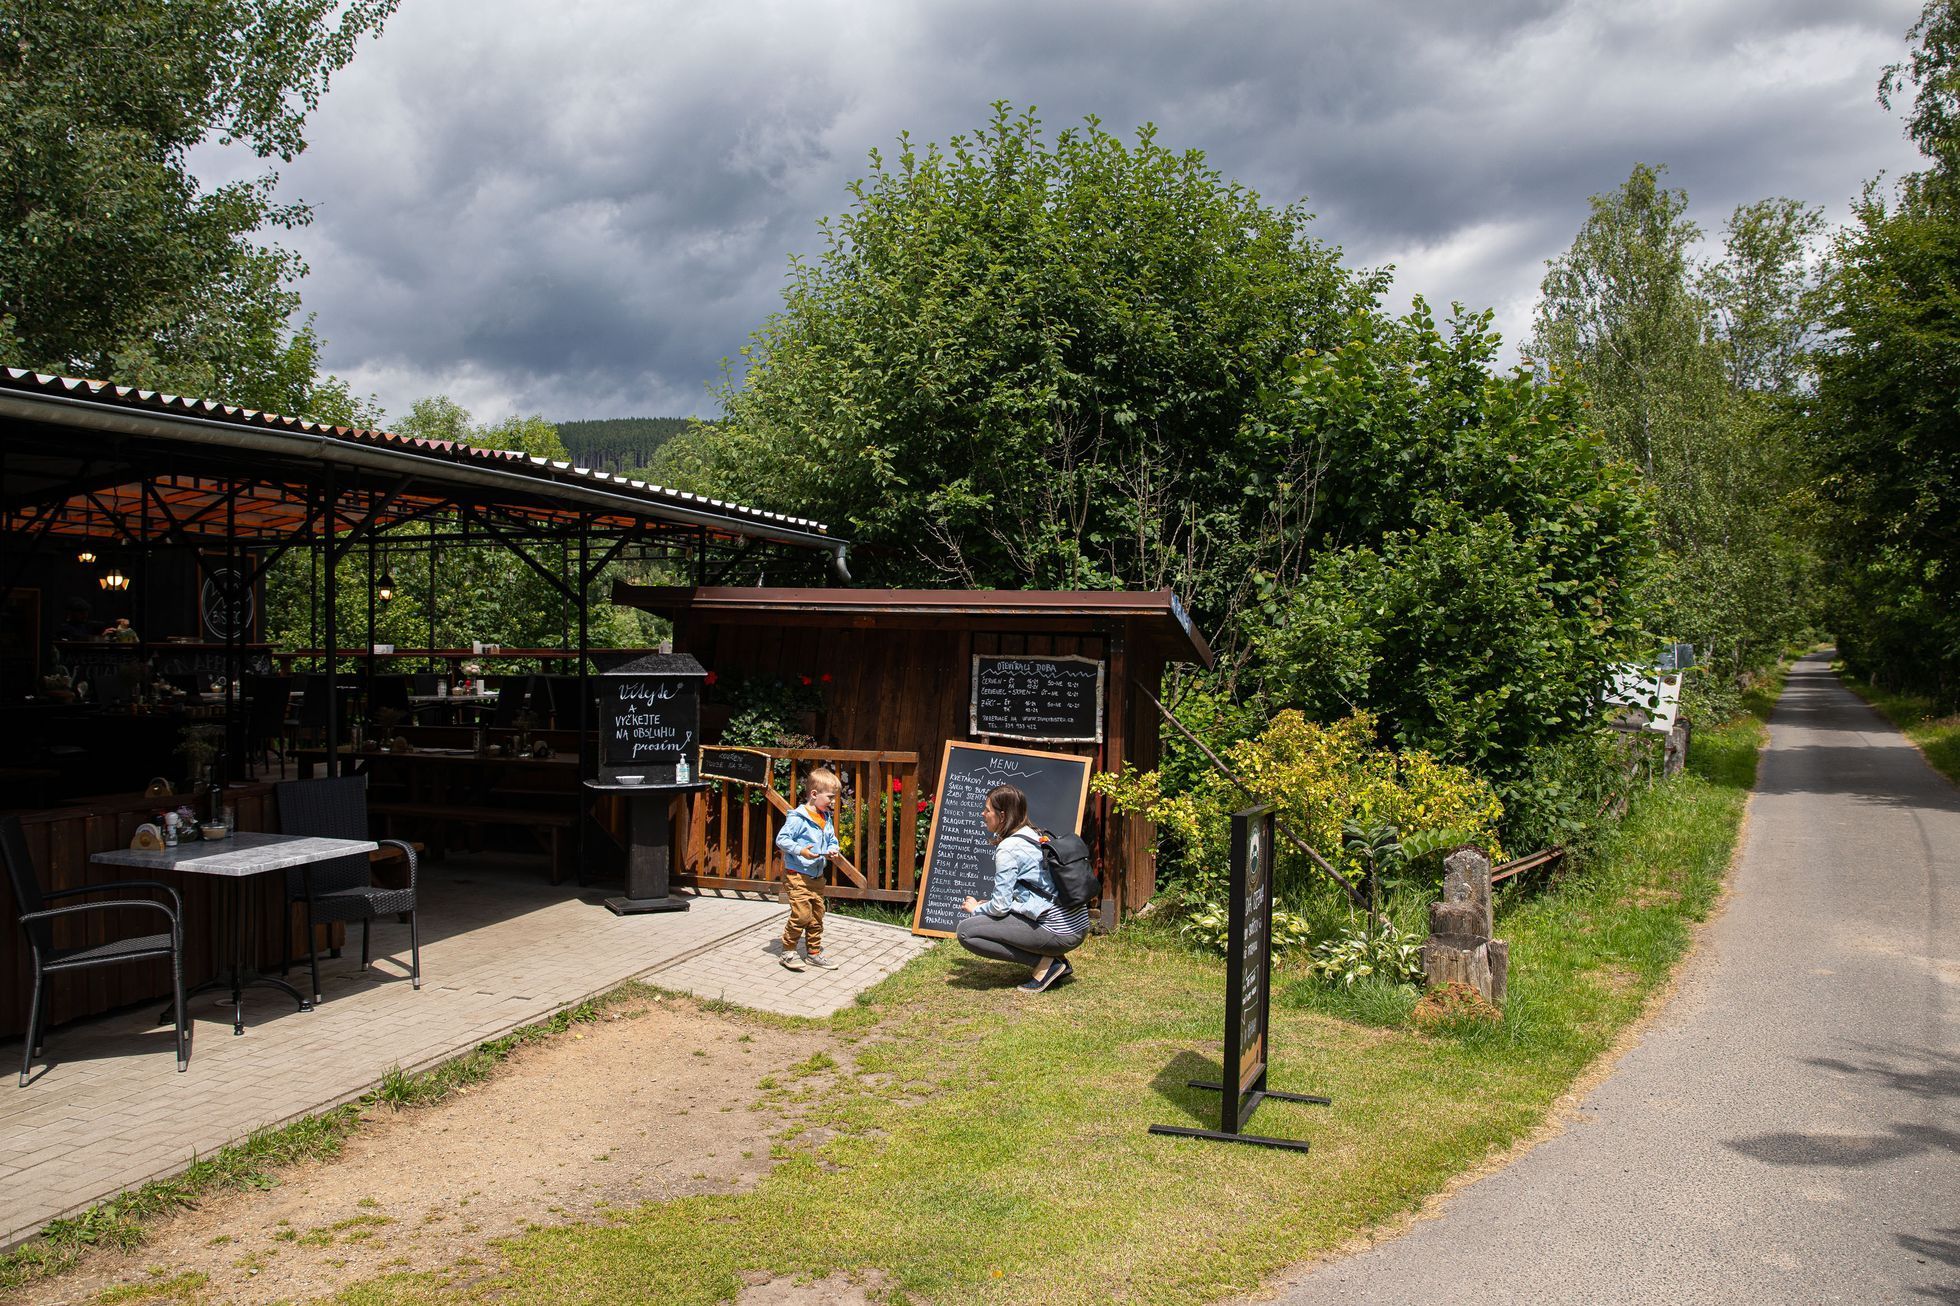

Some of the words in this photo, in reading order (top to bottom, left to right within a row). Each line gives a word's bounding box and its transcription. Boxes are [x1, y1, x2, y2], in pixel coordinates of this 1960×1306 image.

[1036, 663, 1057, 673] DOBA
[628, 704, 637, 713] A
[615, 713, 661, 727] VYČKEJTE
[616, 728, 629, 741] NA
[633, 726, 675, 739] OBSLUHU
[632, 740, 684, 759] prosím
[989, 757, 1019, 771] MENU
[936, 859, 951, 868] FISH
